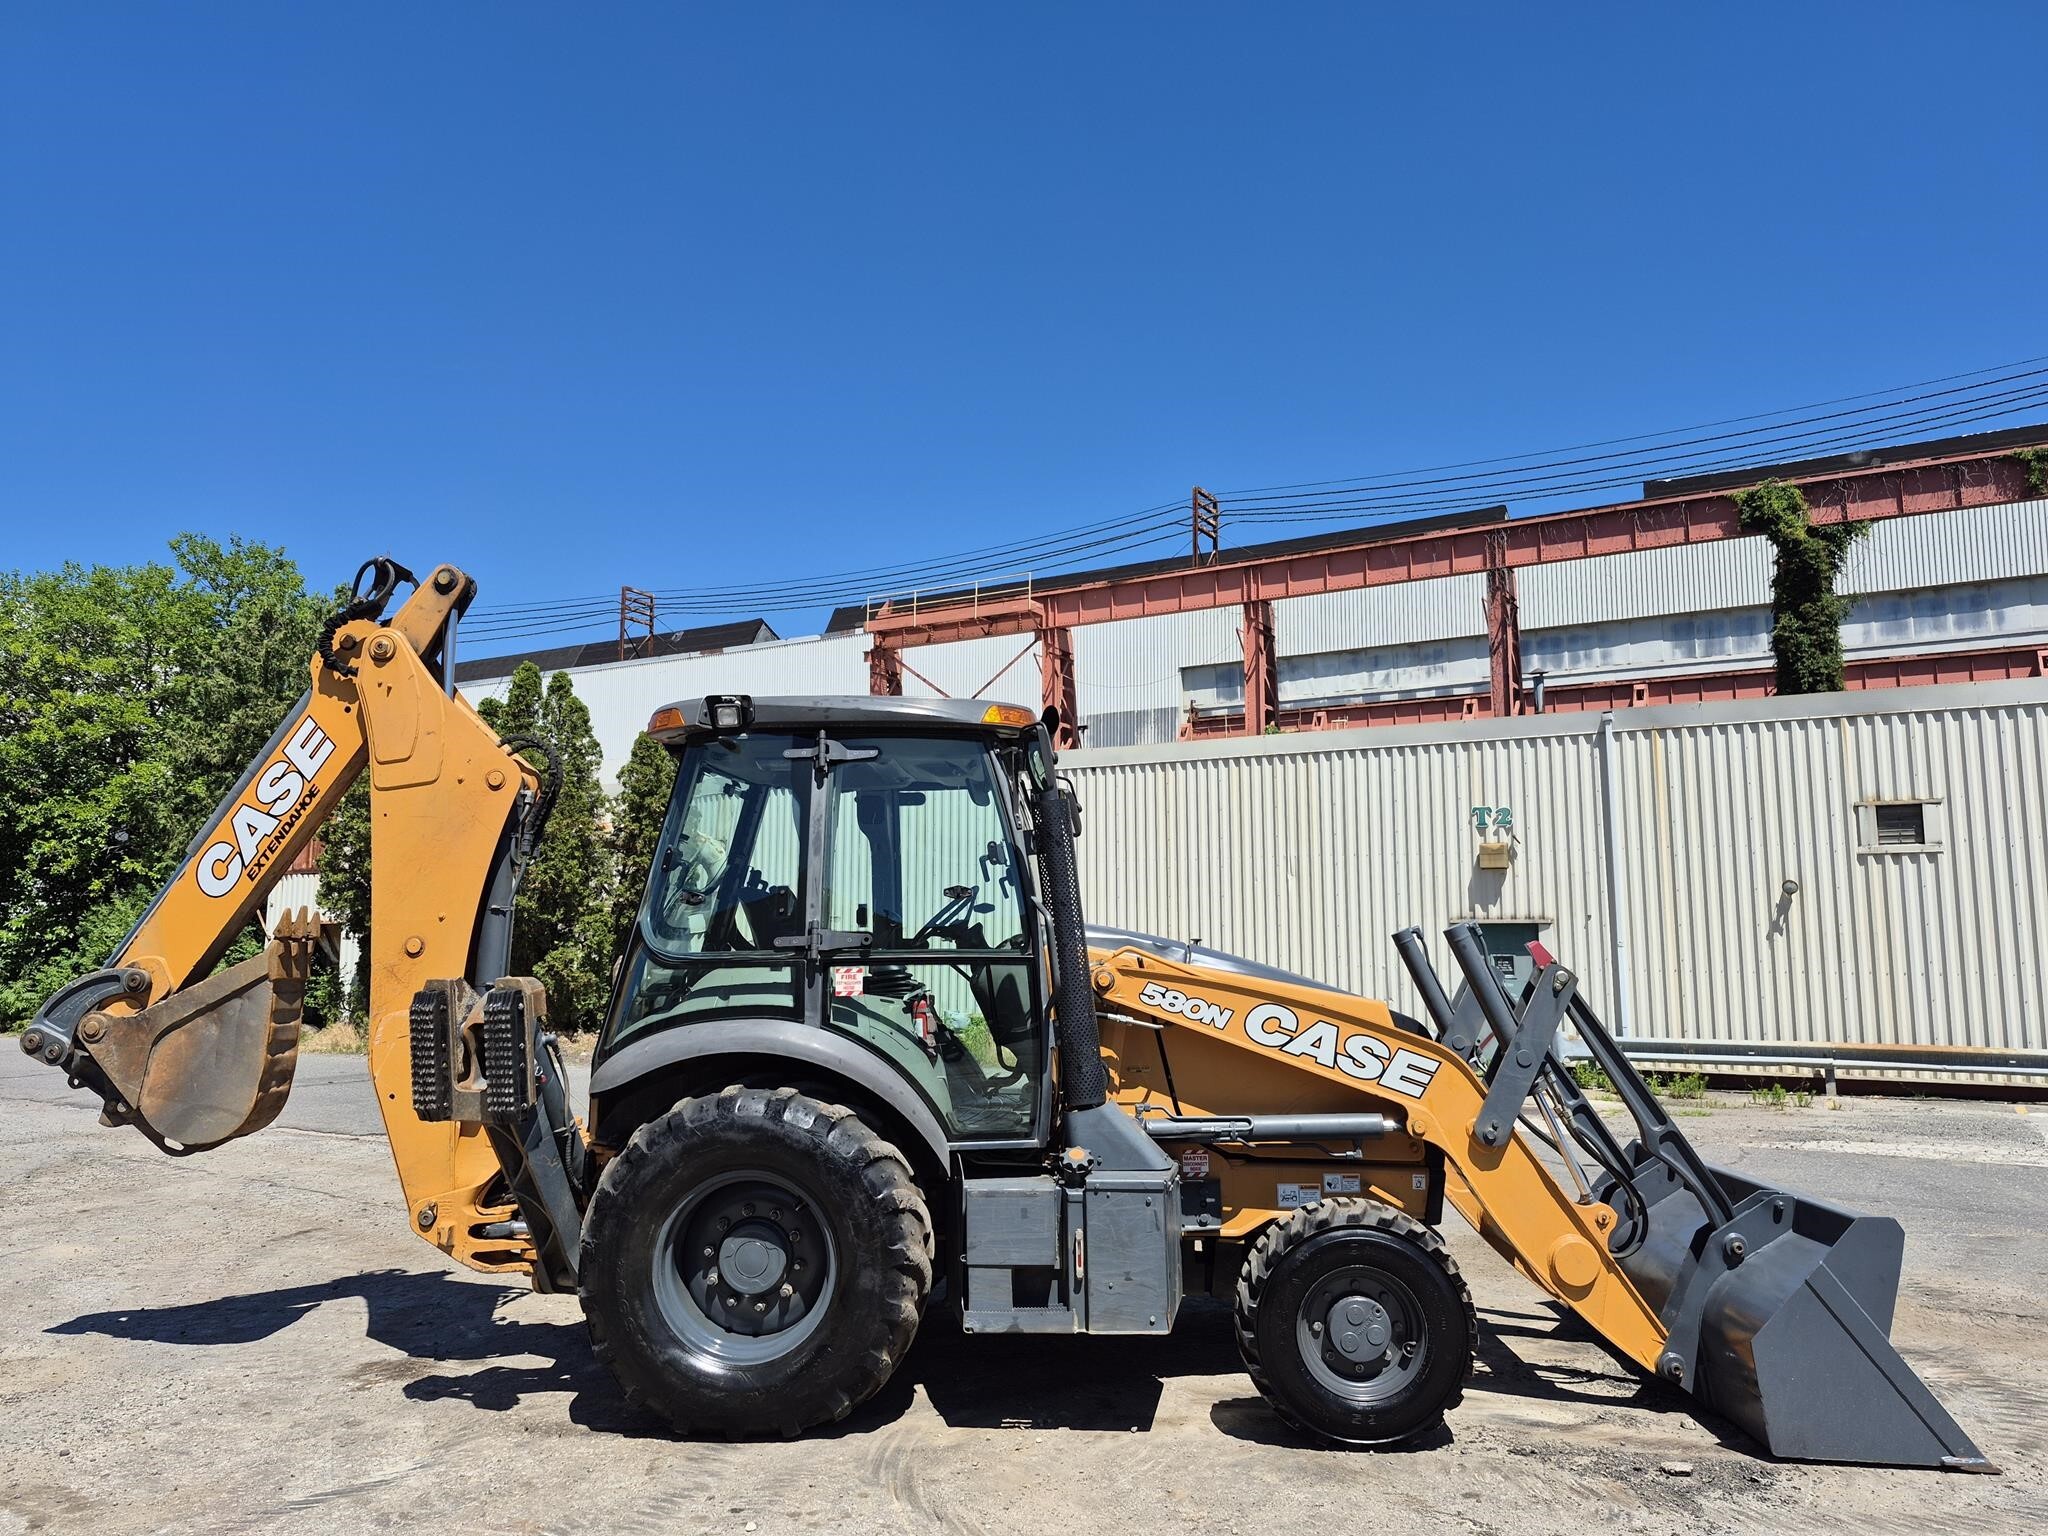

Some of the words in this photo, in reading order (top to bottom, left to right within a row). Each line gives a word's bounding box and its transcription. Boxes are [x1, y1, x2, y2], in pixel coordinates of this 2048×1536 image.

[196, 714, 336, 898] CASE
[247, 783, 320, 882] EXTENDAHOE
[1138, 981, 1234, 1030] 580N
[1244, 1002, 1442, 1099] CASE
